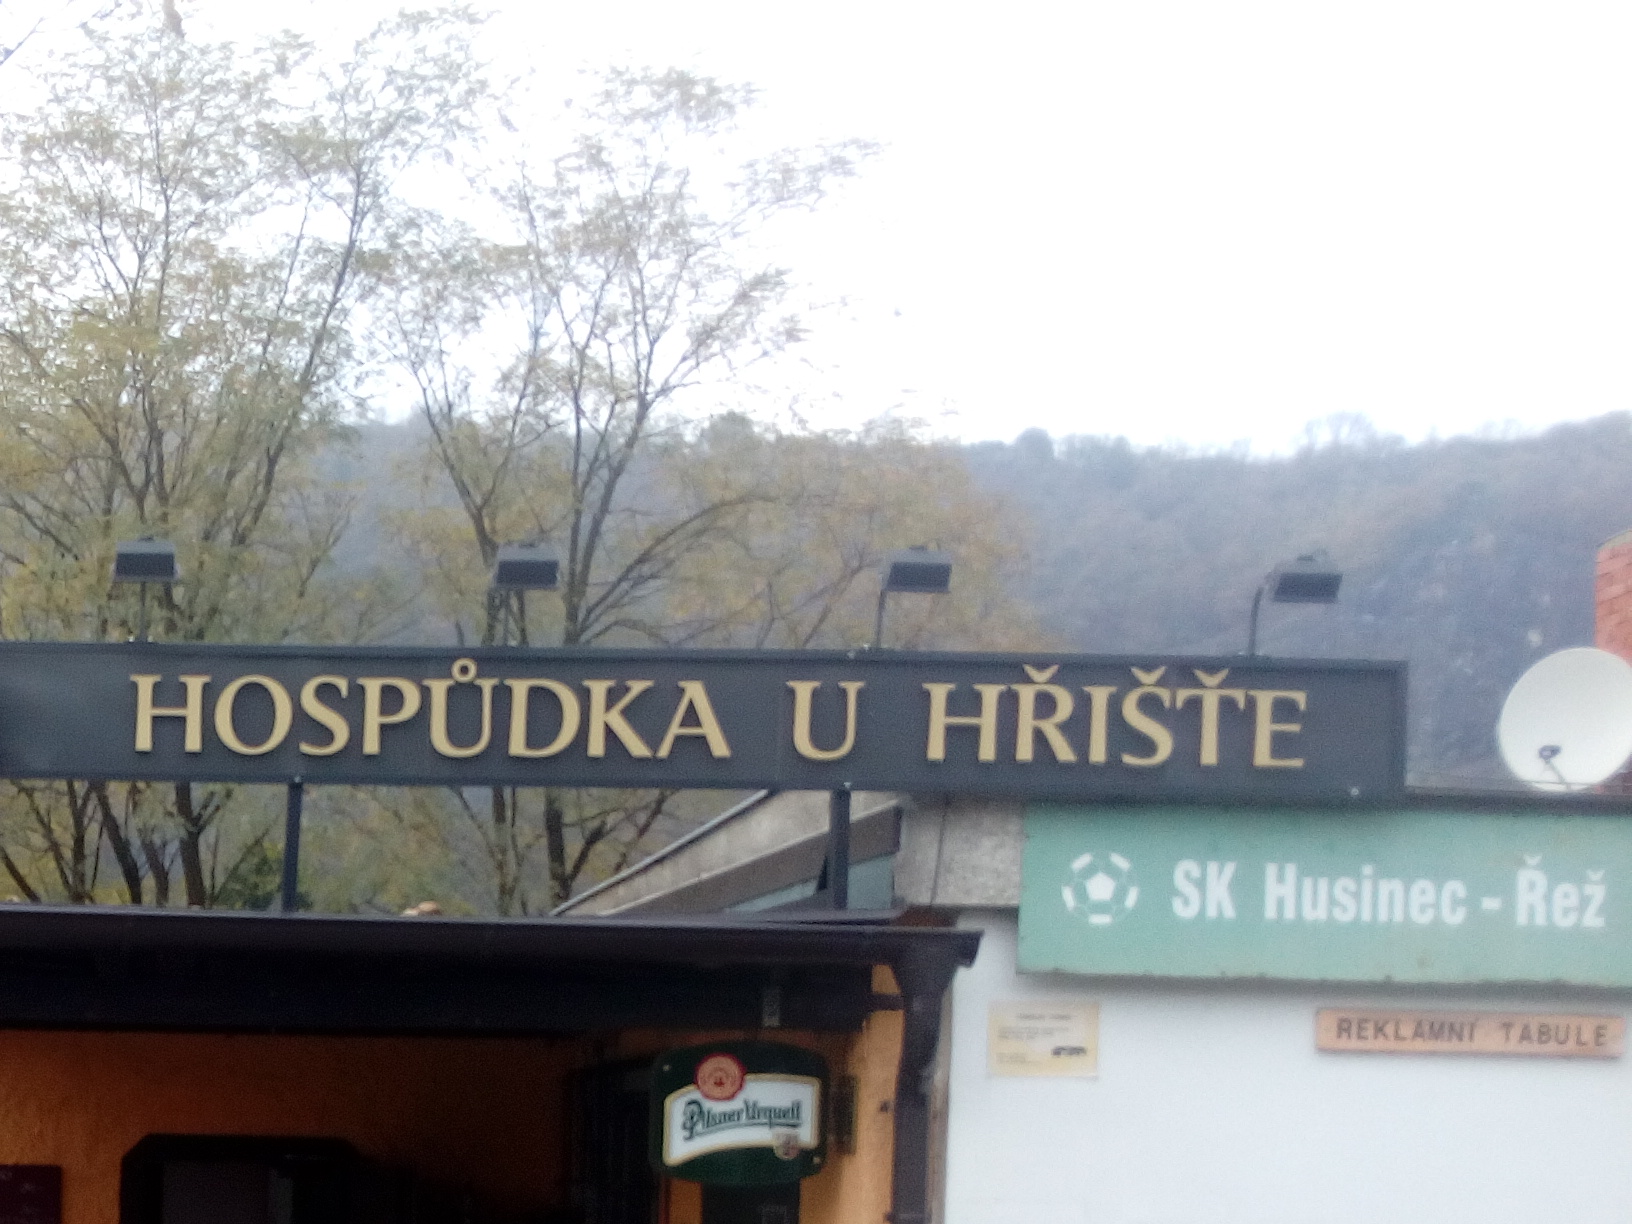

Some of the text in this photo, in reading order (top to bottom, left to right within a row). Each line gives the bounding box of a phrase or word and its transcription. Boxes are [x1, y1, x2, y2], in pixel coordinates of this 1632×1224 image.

[129, 657, 732, 759] HOSPŮDKA
[785, 679, 866, 762] U
[1171, 859, 1237, 921] SK
[1264, 862, 1468, 925] Husinec
[1515, 855, 1606, 928] Řež
[1500, 1021, 1609, 1047] TABULE
[681, 1099, 802, 1141] Pilsner Urquell
